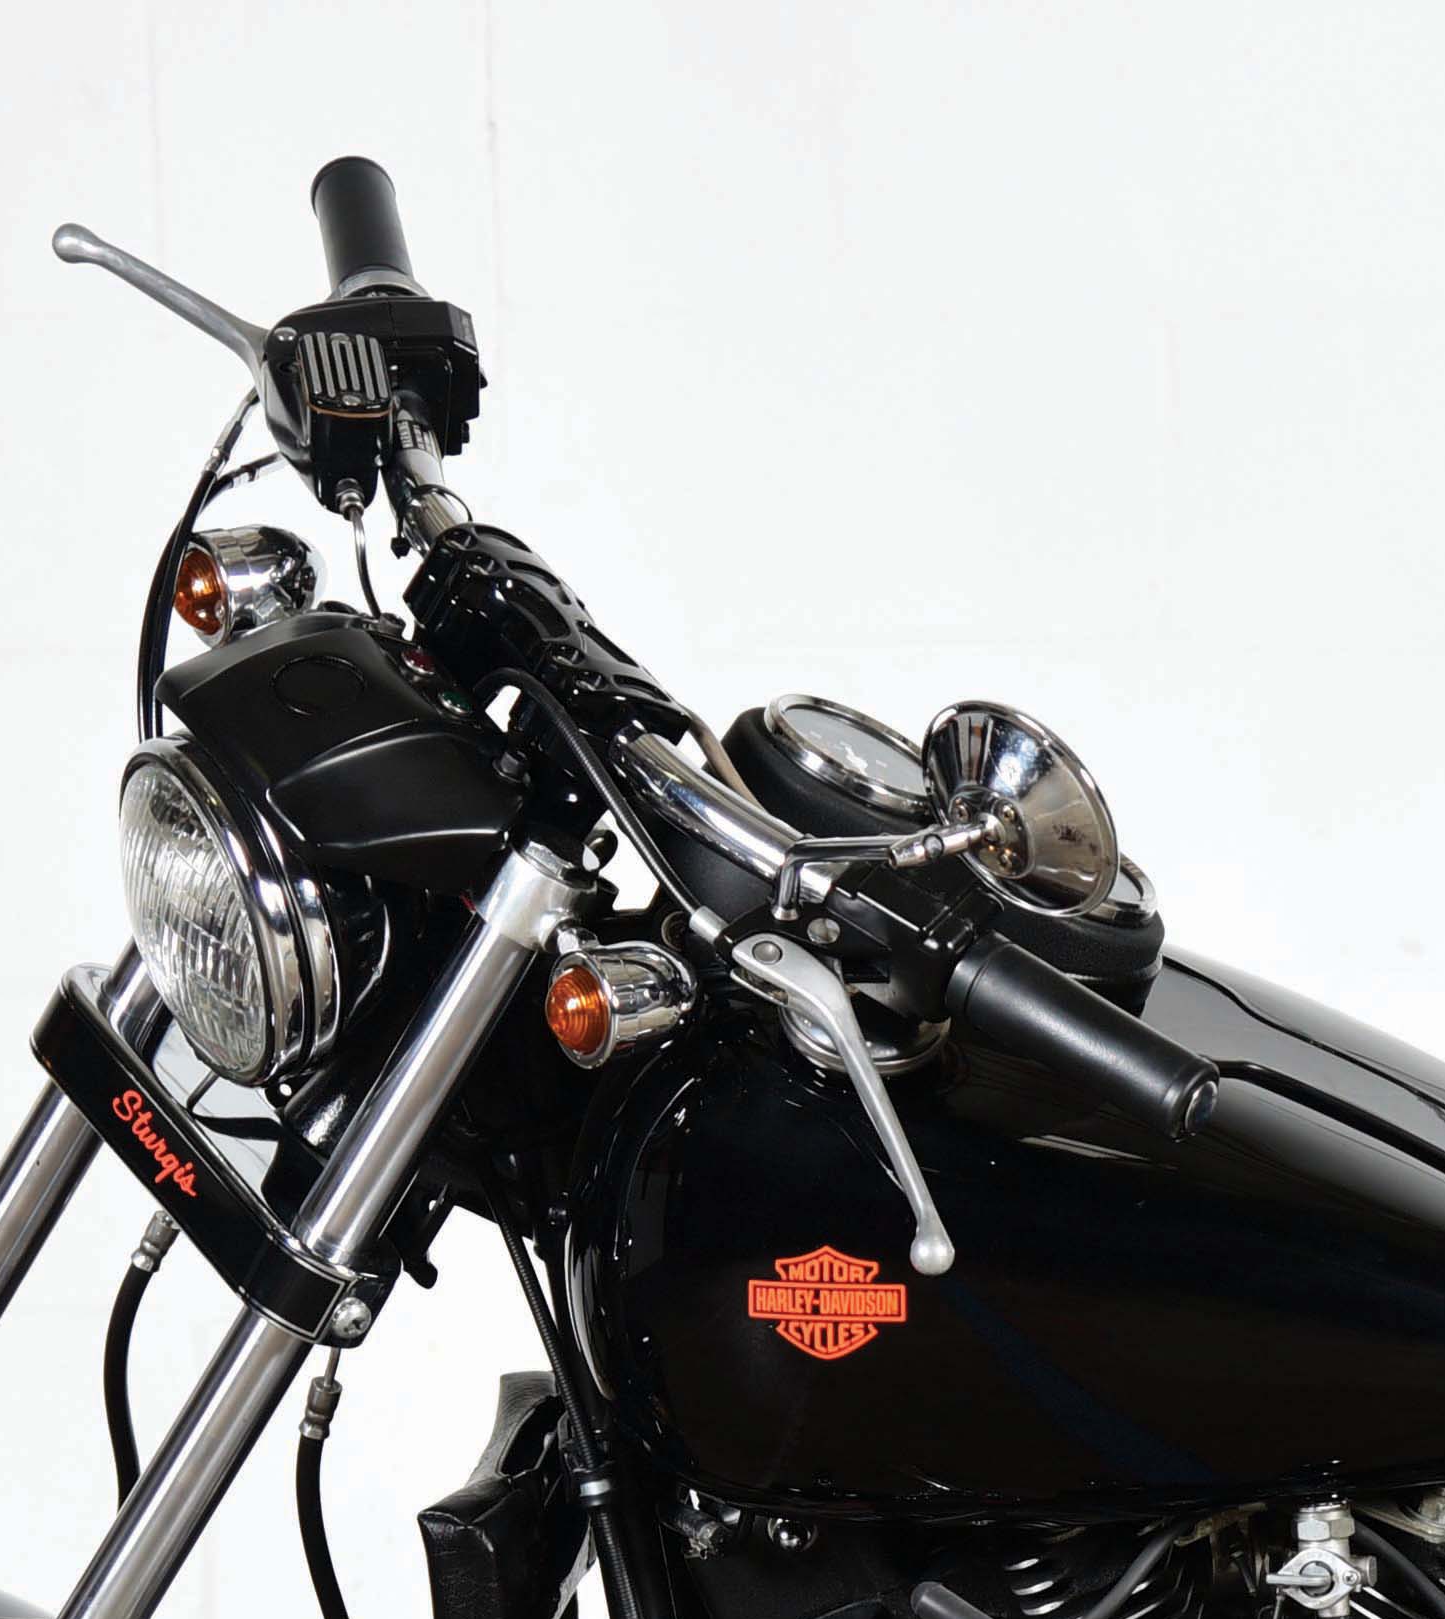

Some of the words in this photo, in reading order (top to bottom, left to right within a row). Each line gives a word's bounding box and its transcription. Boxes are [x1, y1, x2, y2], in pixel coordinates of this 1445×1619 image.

[112, 1089, 197, 1198] Sturgis
[788, 1254, 867, 1282] MOTOR
[755, 1287, 899, 1317] HARLEY-DAVIDSON
[788, 1321, 866, 1354] CYCLES
